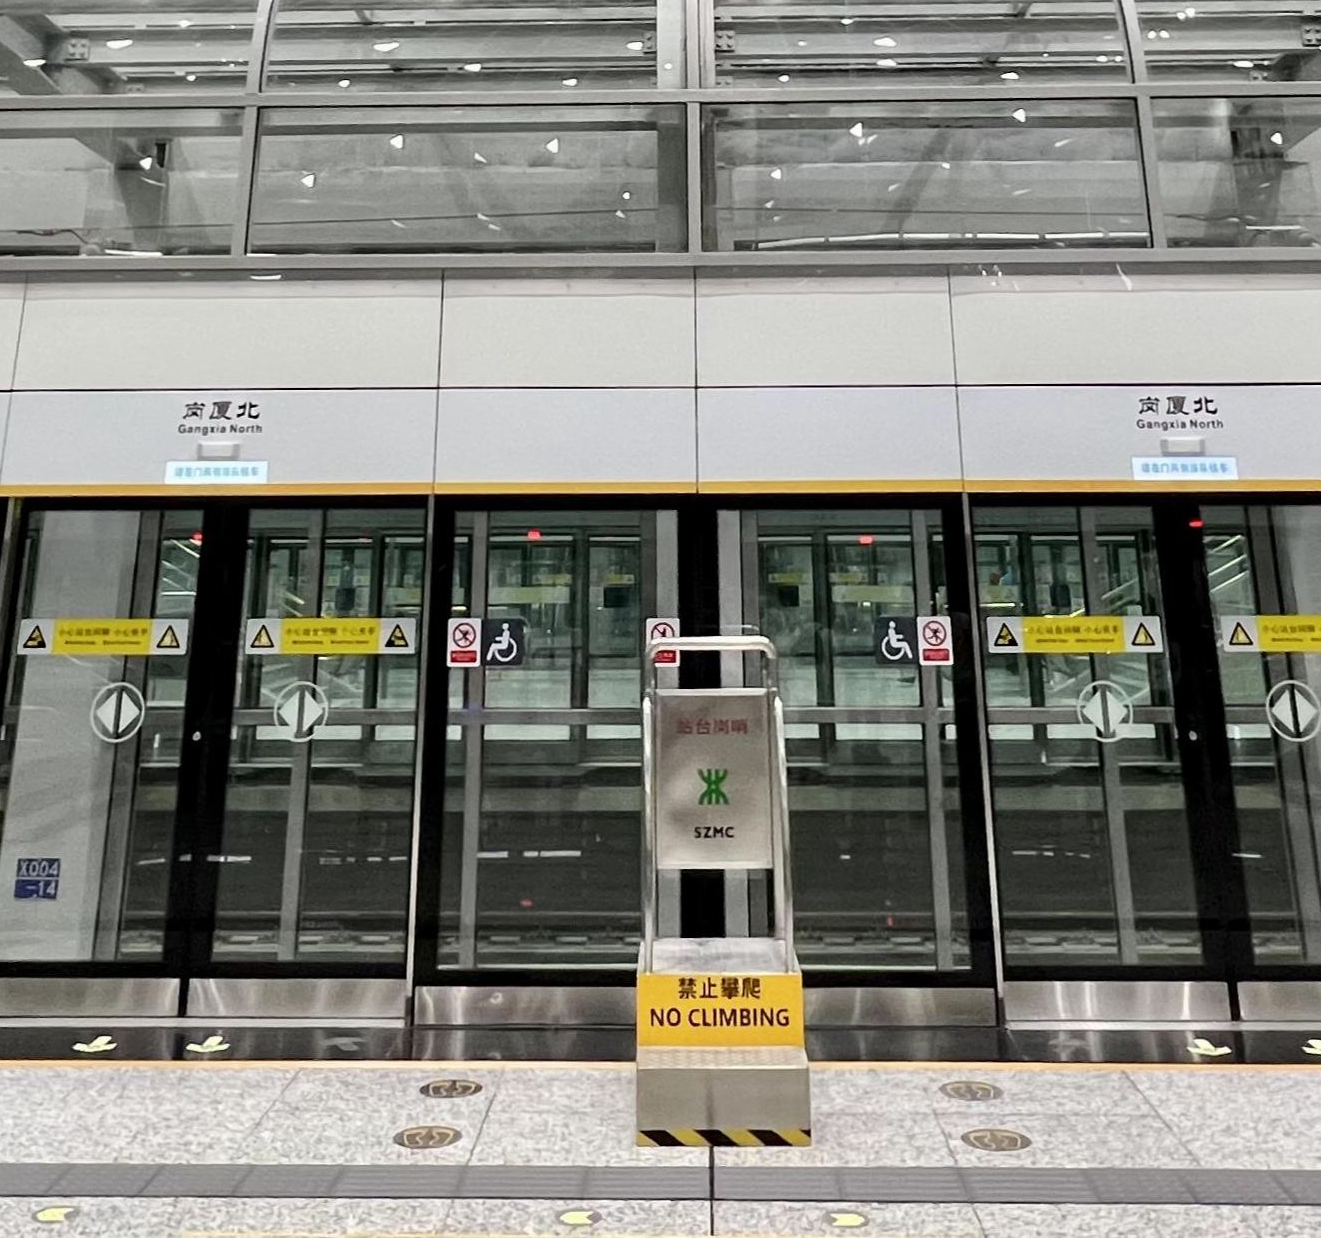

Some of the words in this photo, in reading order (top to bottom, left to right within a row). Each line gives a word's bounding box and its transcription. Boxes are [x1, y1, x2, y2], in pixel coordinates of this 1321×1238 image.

[182, 400, 261, 420] 岗厦北
[1138, 395, 1218, 415] 岗厦北
[177, 423, 227, 436] Gangxia
[229, 424, 263, 434] North
[1136, 418, 1187, 431] Gangxia
[1190, 418, 1224, 429] North
[676, 718, 748, 736] 站台岗哨
[694, 826, 735, 839] SZMC
[19, 860, 59, 877] X004
[678, 976, 762, 1000] 禁止攀爬
[650, 1007, 682, 1027] NO
[688, 1007, 791, 1027] CLIMBING
